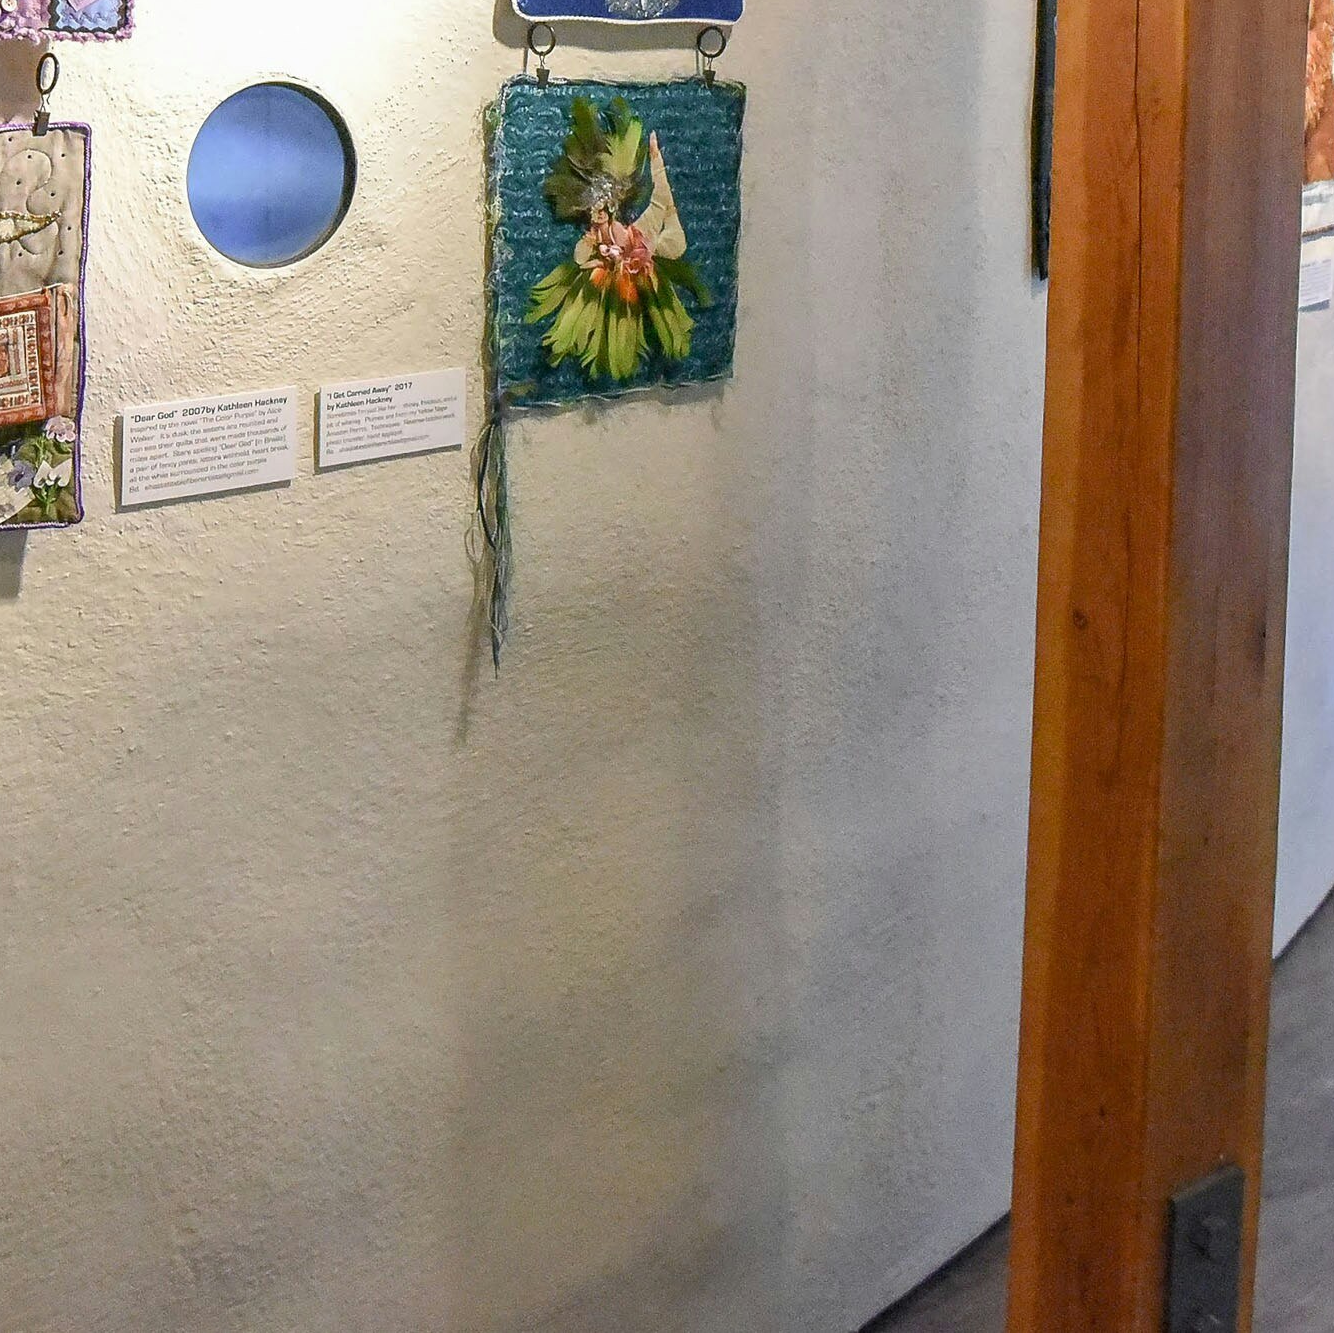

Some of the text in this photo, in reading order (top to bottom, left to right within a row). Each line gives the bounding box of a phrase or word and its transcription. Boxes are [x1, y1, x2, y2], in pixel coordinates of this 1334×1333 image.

[395, 382, 412, 391] 2017
[336, 400, 364, 409] Kathleen
[366, 397, 392, 405] Hackney
[130, 414, 155, 423] "Dear
[158, 410, 178, 419] God"
[218, 401, 252, 412] Kathleen
[255, 397, 287, 406] Hackney
